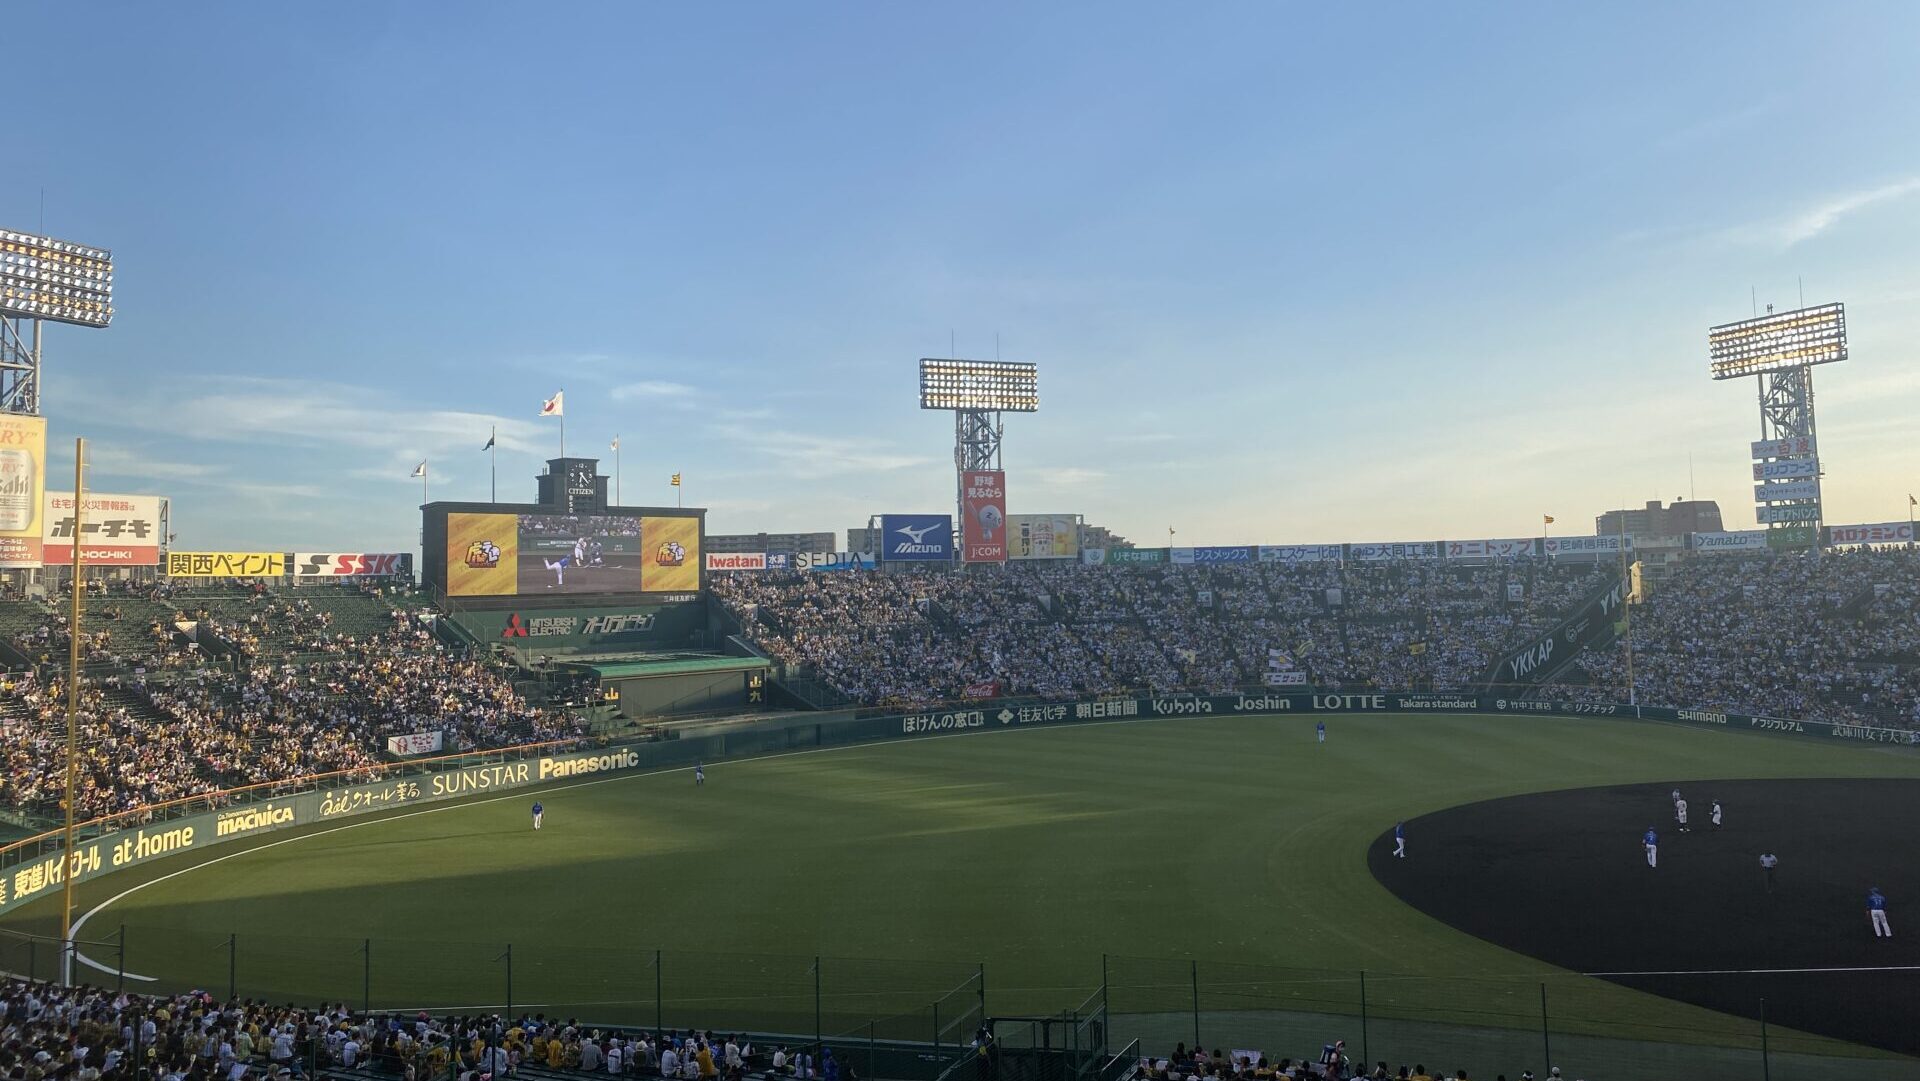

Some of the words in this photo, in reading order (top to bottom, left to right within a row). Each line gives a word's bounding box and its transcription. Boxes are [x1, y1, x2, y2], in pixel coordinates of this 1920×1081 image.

[974, 475, 995, 487] 野球
[568, 487, 594, 495] CITIZEN
[967, 488, 1002, 499] 見るなら
[51, 516, 151, 538] ホーチキ
[1831, 526, 1912, 542] オロナミンC
[1697, 536, 1748, 547] Yamato
[971, 546, 1001, 559] J:COM
[1113, 552, 1160, 561] りそな銀行
[1195, 549, 1249, 561] シスメックス
[1276, 546, 1341, 560] エスケー化研
[1377, 544, 1436, 557] 大同工業
[170, 554, 283, 574] 関西ペイント
[333, 555, 397, 575] SSK
[709, 555, 764, 567] Iwatani
[796, 552, 864, 568] SEDIA
[529, 617, 578, 628] MITSUBISHI
[529, 626, 572, 637] ELECTRIC
[1510, 648, 1536, 680] YKK
[1538, 638, 1554, 666] AP
[1152, 698, 1212, 714] Kubota
[1234, 696, 1290, 710] Joshin
[1313, 695, 1386, 709] LOTTE
[1399, 699, 1430, 708] Takara
[1432, 699, 1477, 709] standard
[1019, 705, 1067, 723] 住友化学
[1076, 701, 1138, 719] 朝日新聞
[903, 711, 979, 732] ほけんの窓口
[1677, 711, 1727, 724] SHIMANO
[539, 748, 639, 780] Panasonic
[432, 763, 528, 796] SUNSTAR
[353, 781, 420, 808] クオール薬局
[113, 840, 132, 866] at
[134, 826, 194, 859] home
